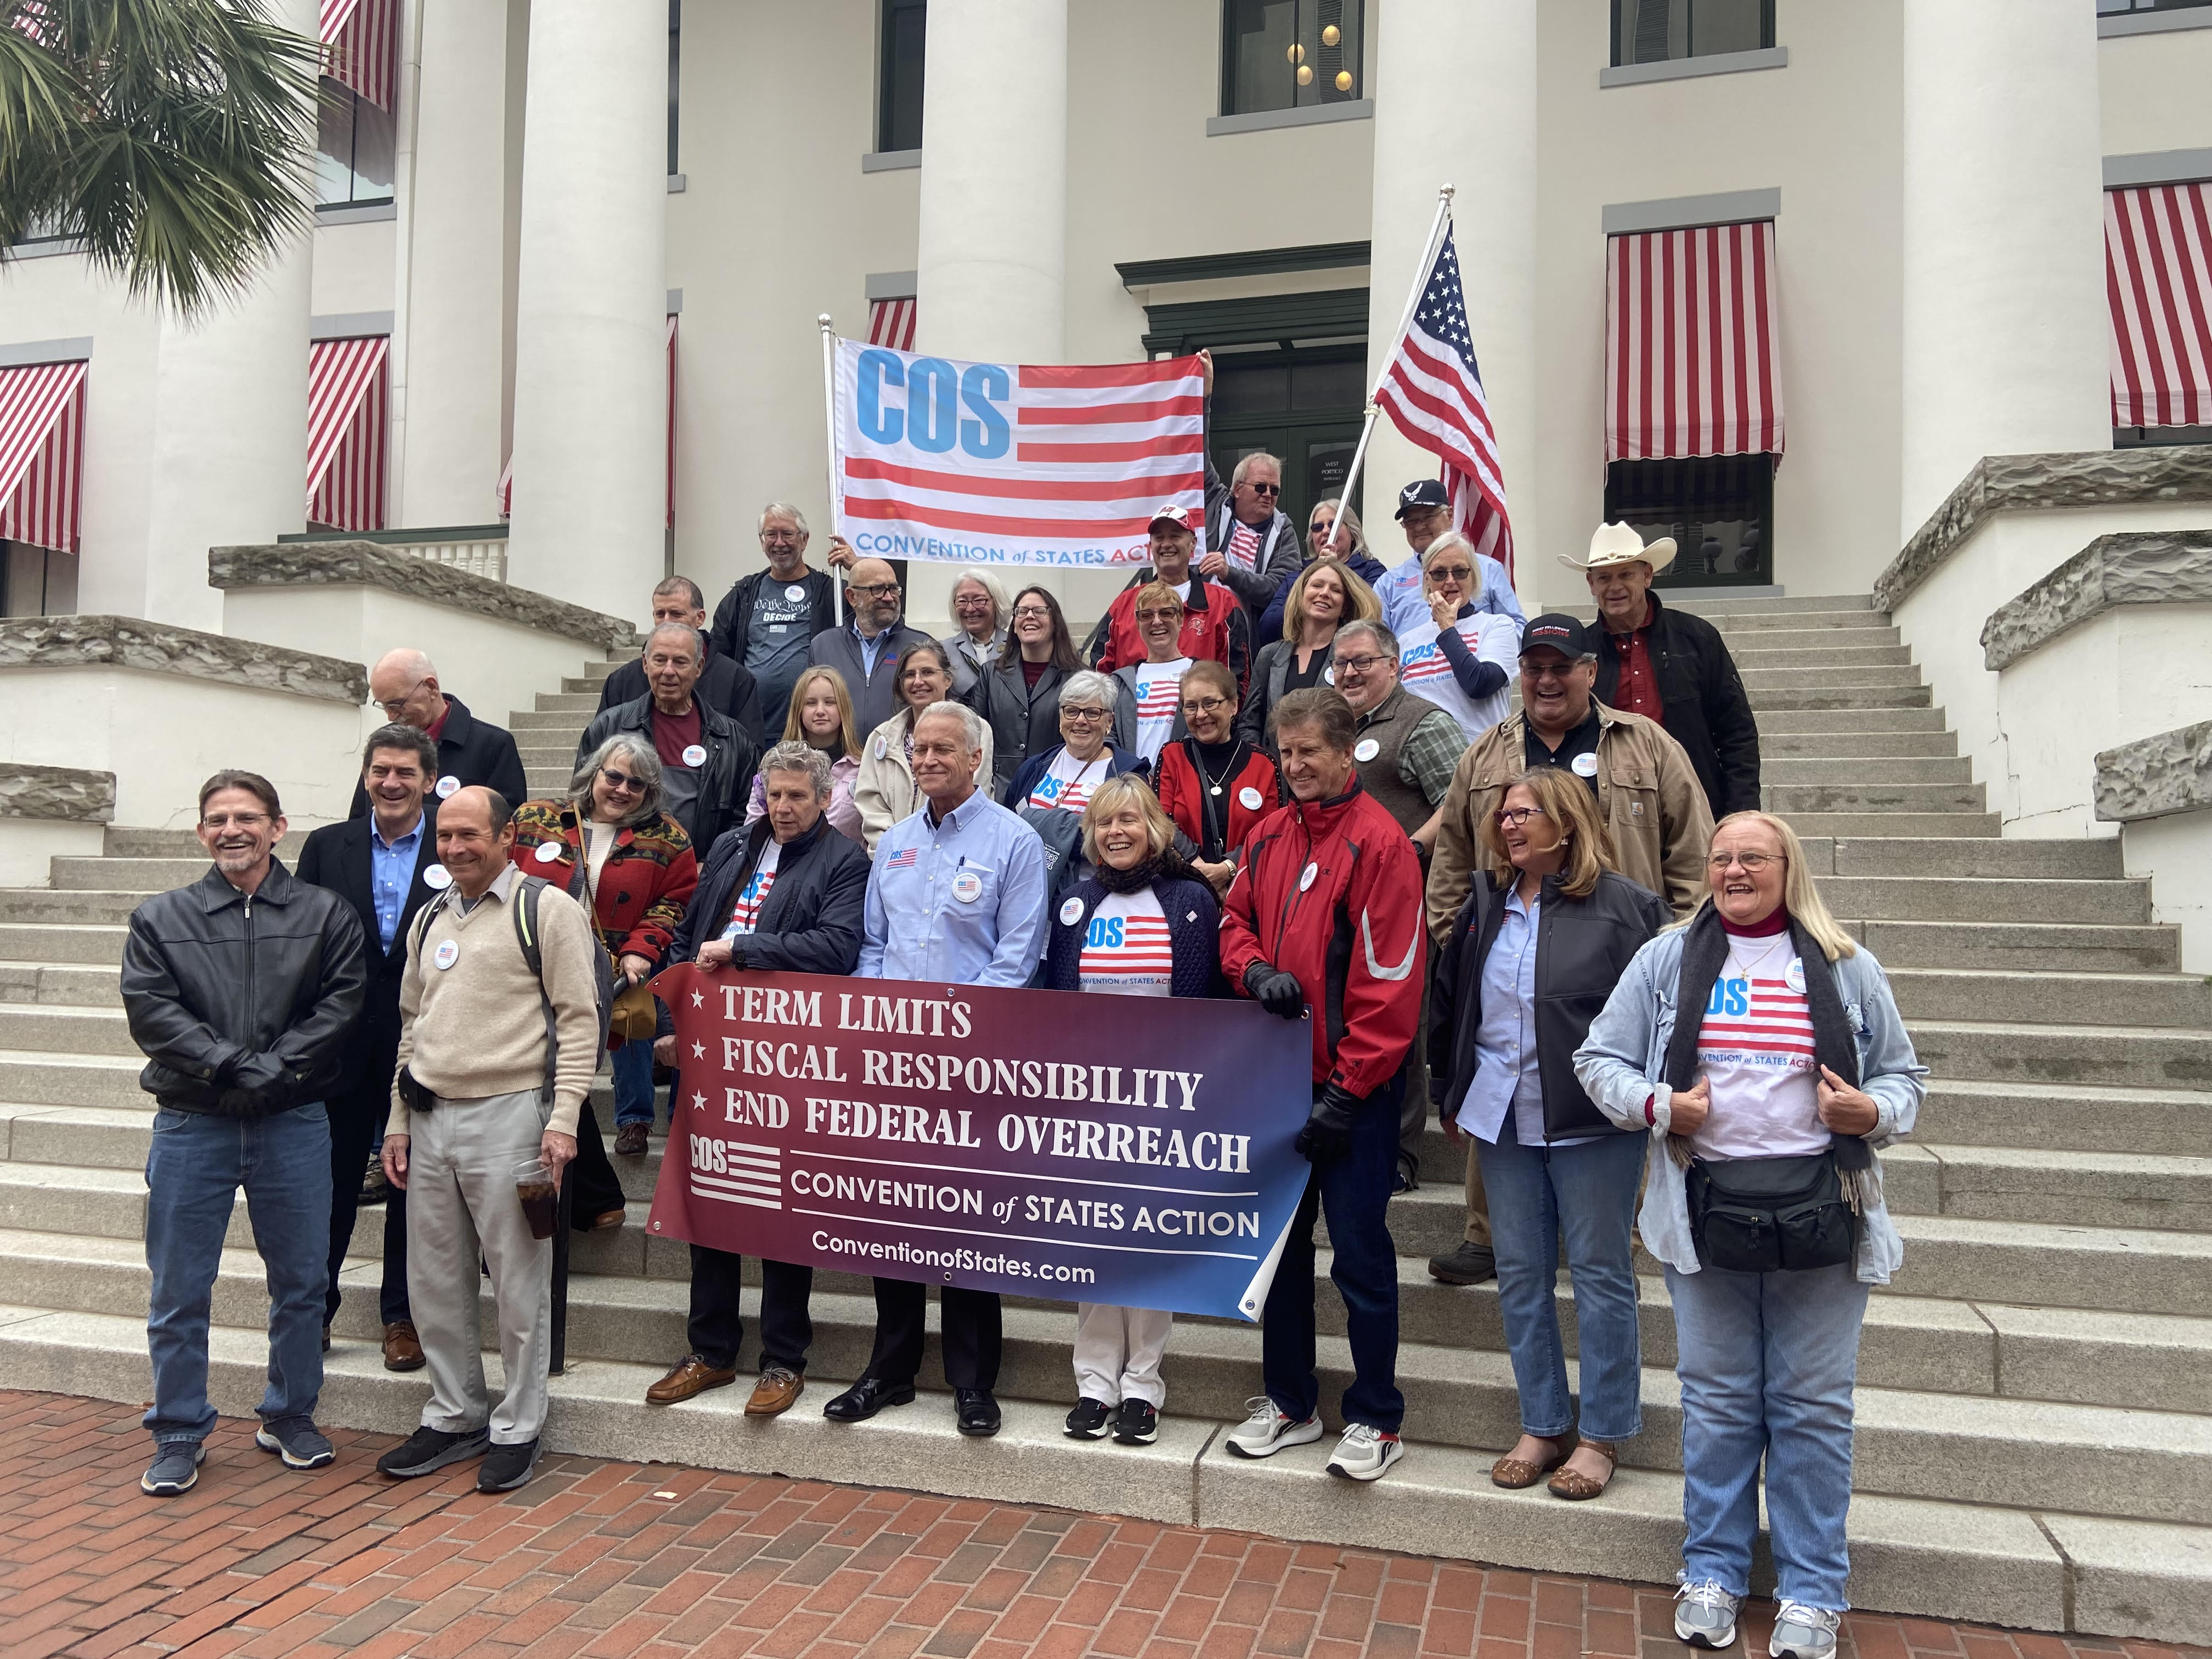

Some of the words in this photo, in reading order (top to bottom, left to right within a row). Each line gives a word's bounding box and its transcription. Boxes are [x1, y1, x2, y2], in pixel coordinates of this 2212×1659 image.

[857, 349, 1010, 459] COS
[856, 532, 1005, 561] CONVENTION
[1012, 550, 1028, 565] of
[1035, 549, 1105, 565] STATES
[763, 612, 797, 622] DECIDE
[1531, 629, 1570, 637] MISSIONS
[1402, 642, 1437, 666] COS
[1032, 773, 1064, 799] OS
[890, 850, 902, 860] COS
[1081, 917, 1123, 948] OS
[720, 985, 823, 1028] TERM
[837, 993, 972, 1039] LIMITS
[1705, 977, 1748, 1016] OS
[721, 1036, 847, 1083] FISCAL
[861, 1048, 1204, 1111] RESPONSIBILITY
[1755, 1056, 1787, 1065] STATES
[724, 1087, 789, 1129] END
[804, 1097, 981, 1148] FEDERAL
[997, 1114, 1251, 1173] OVERREACH
[690, 1132, 727, 1175] COS
[791, 1169, 983, 1215] CONVENTION
[992, 1196, 1019, 1224] of
[1024, 1194, 1125, 1231] STATES
[1131, 1206, 1259, 1238] ACTION
[811, 1230, 1096, 1284] ConventionofStates.com
